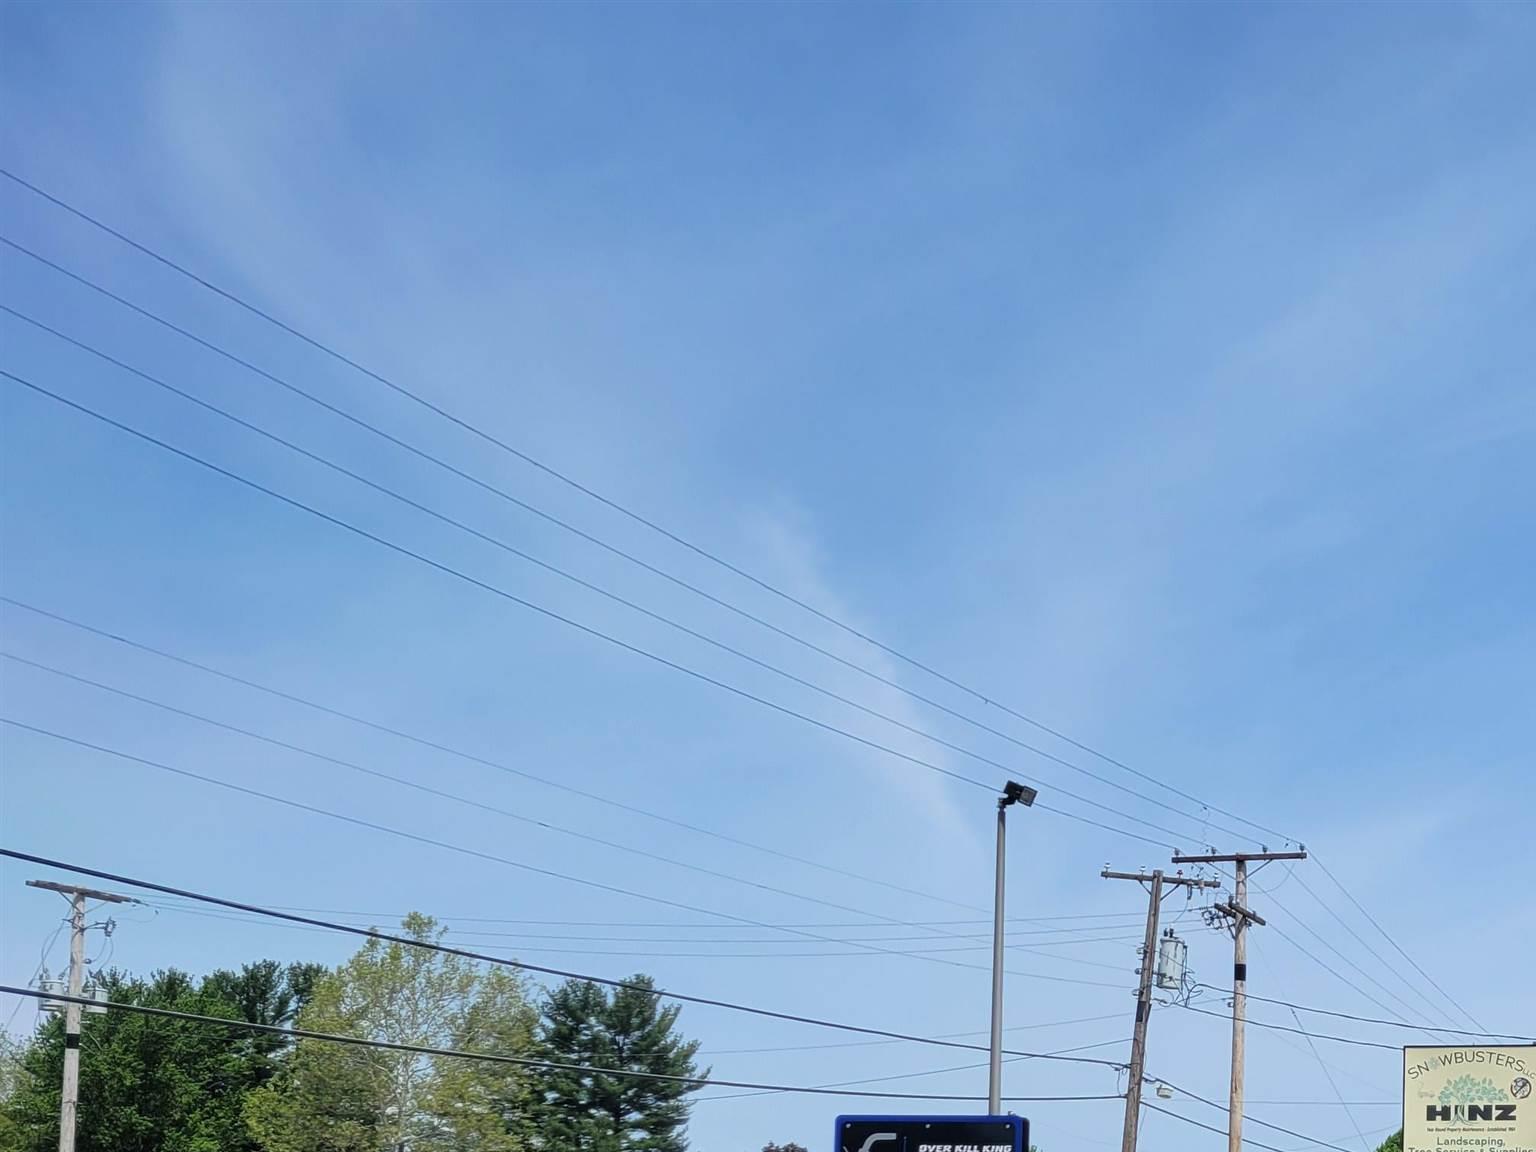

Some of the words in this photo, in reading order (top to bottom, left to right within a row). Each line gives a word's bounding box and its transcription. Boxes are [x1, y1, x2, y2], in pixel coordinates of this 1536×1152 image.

[1426, 1104, 1517, 1122] HINZ
[1436, 1136, 1506, 1147] Landscaping,
[918, 1144, 952, 1152] OVER
[954, 1144, 980, 1152] KILL
[982, 1144, 1013, 1152] KING
